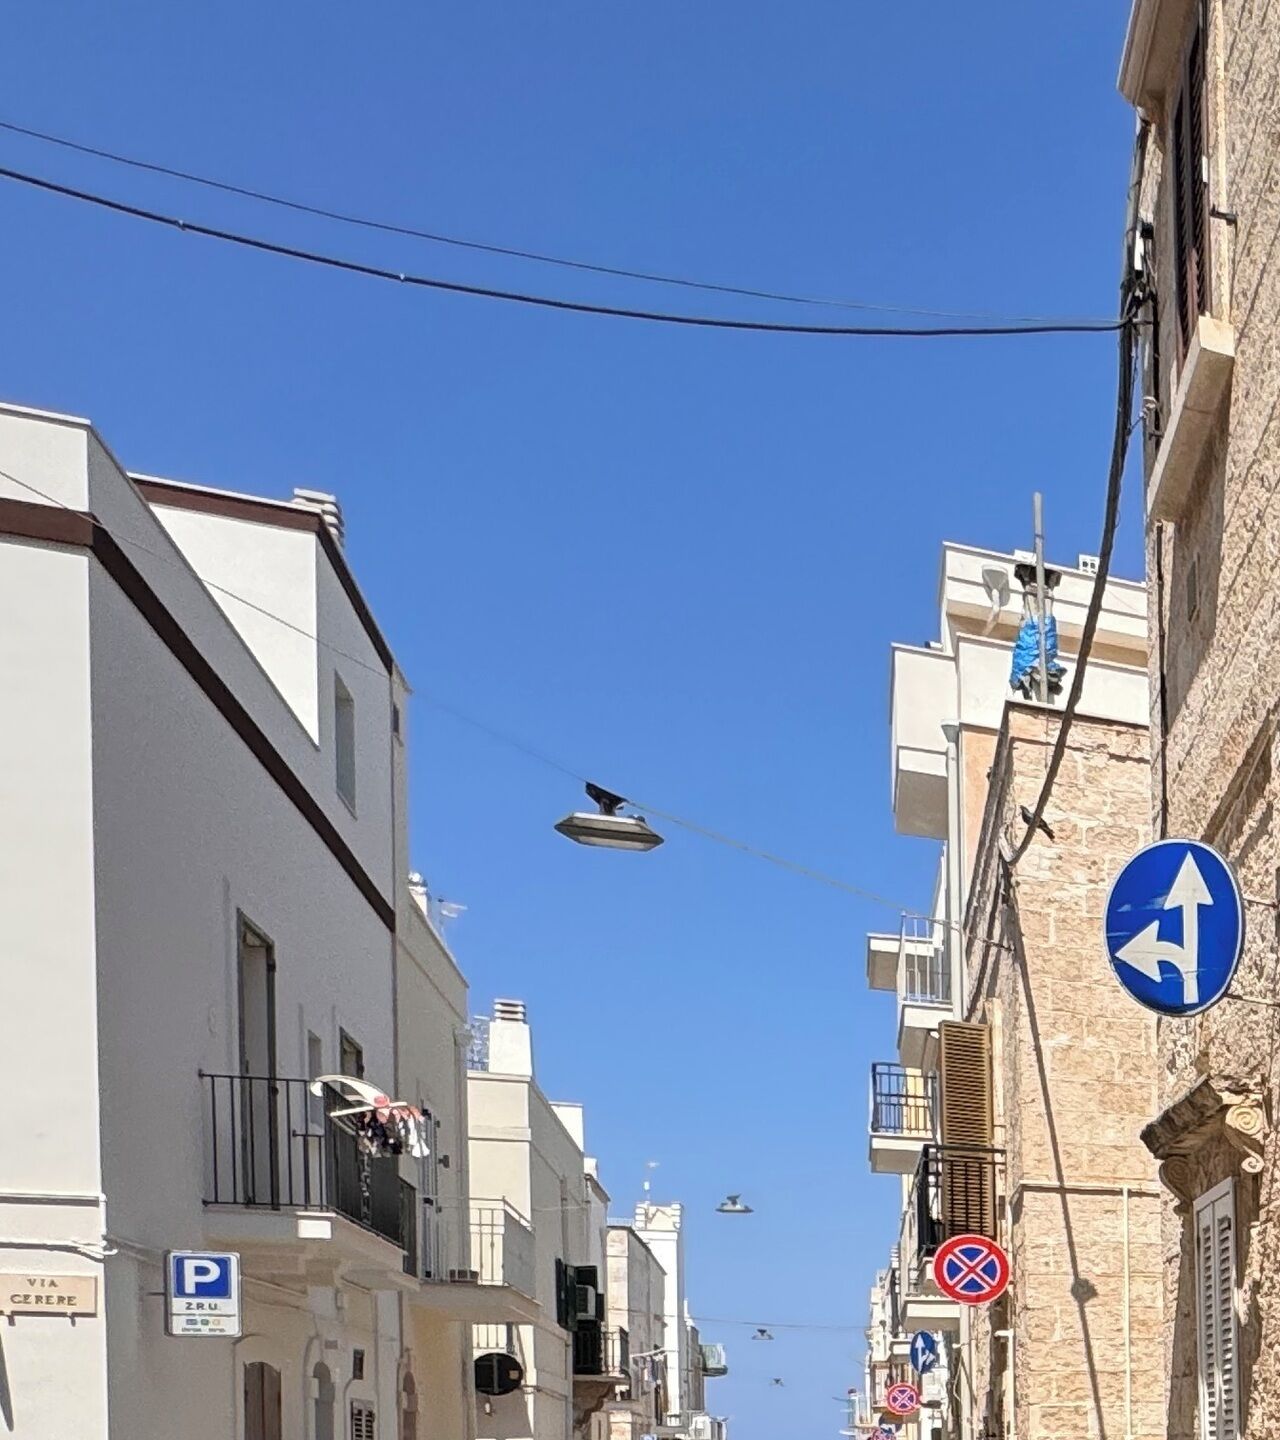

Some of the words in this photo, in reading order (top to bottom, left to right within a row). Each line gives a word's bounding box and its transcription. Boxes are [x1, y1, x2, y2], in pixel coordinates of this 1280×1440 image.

[26, 1278, 59, 1288] VIA
[184, 1259, 221, 1295] P
[10, 1294, 77, 1306] CERERE
